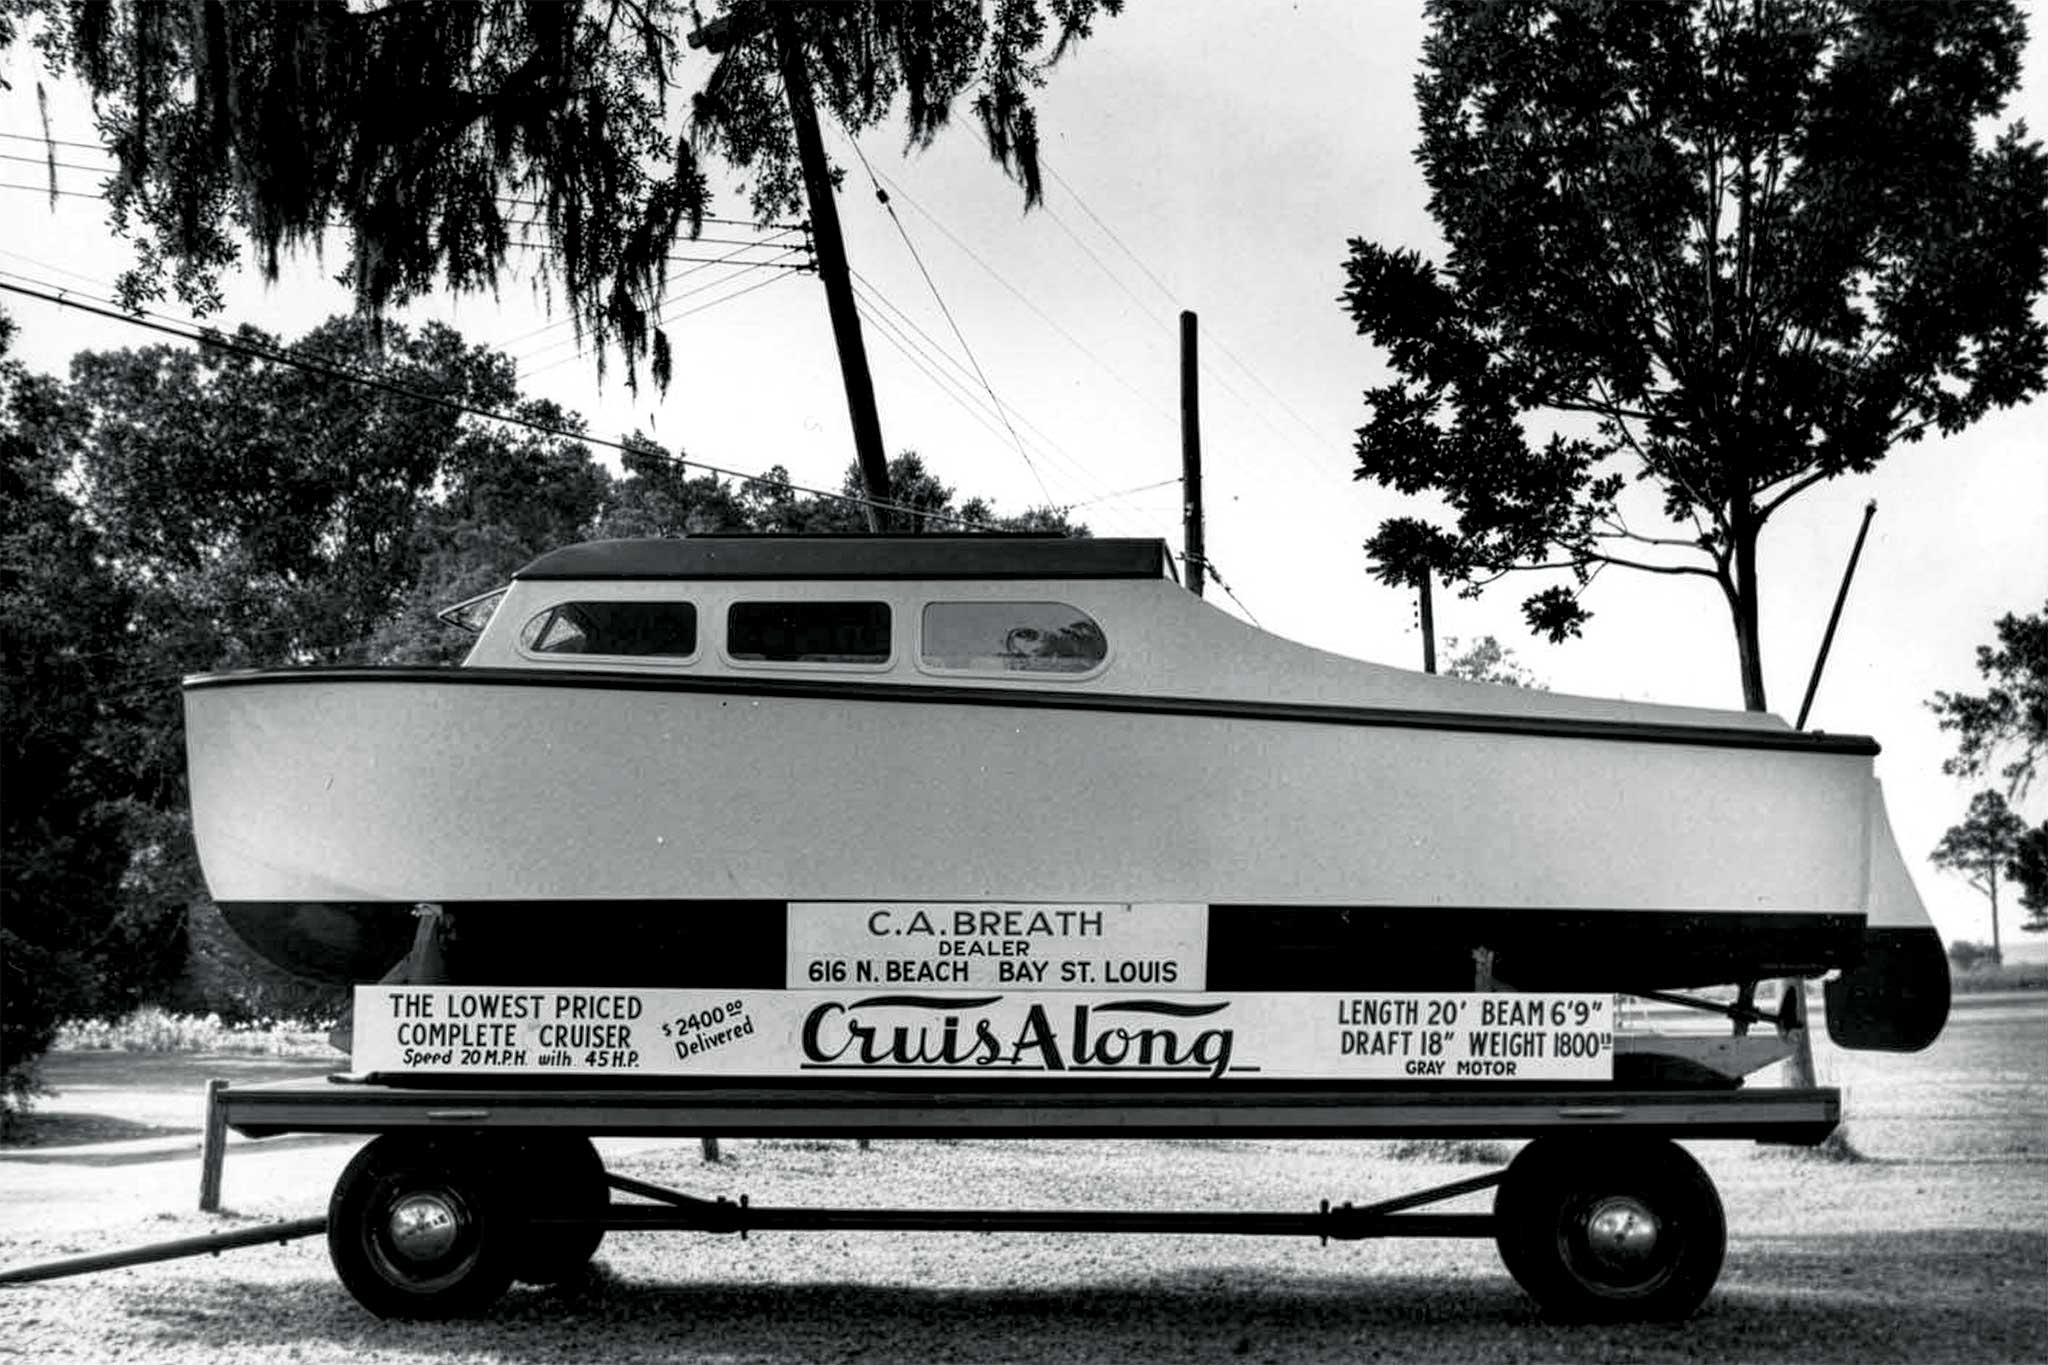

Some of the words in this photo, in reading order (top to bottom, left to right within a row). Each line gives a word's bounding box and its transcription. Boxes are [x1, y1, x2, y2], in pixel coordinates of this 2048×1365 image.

[939, 940, 1029, 956] DEALER
[809, 961, 846, 982] 616
[857, 961, 879, 982] N.
[887, 960, 968, 982] BEACH
[1000, 960, 1048, 982] BAY
[1062, 962, 1095, 982] ST.
[1106, 961, 1177, 983] LOUIS
[389, 994, 433, 1018] THE
[449, 994, 545, 1019] LOWEST
[556, 995, 642, 1019] PRICED
[1339, 999, 1418, 1025] LENGTH
[1481, 1001, 1544, 1026] BEAM
[397, 1023, 516, 1046] COMPLETE
[540, 1024, 631, 1048] CRUISER
[676, 1015, 754, 1059] Delivered
[1341, 1031, 1413, 1055] DRAFT
[1470, 1032, 1547, 1057] WEIGHT
[403, 1049, 452, 1067] Speed
[460, 1050, 481, 1065] 20
[538, 1051, 572, 1067] with
[584, 1051, 608, 1067] 45
[612, 1052, 640, 1067] H.P.
[1406, 1060, 1445, 1075] GRAY
[1457, 1061, 1517, 1076] MOTOR
